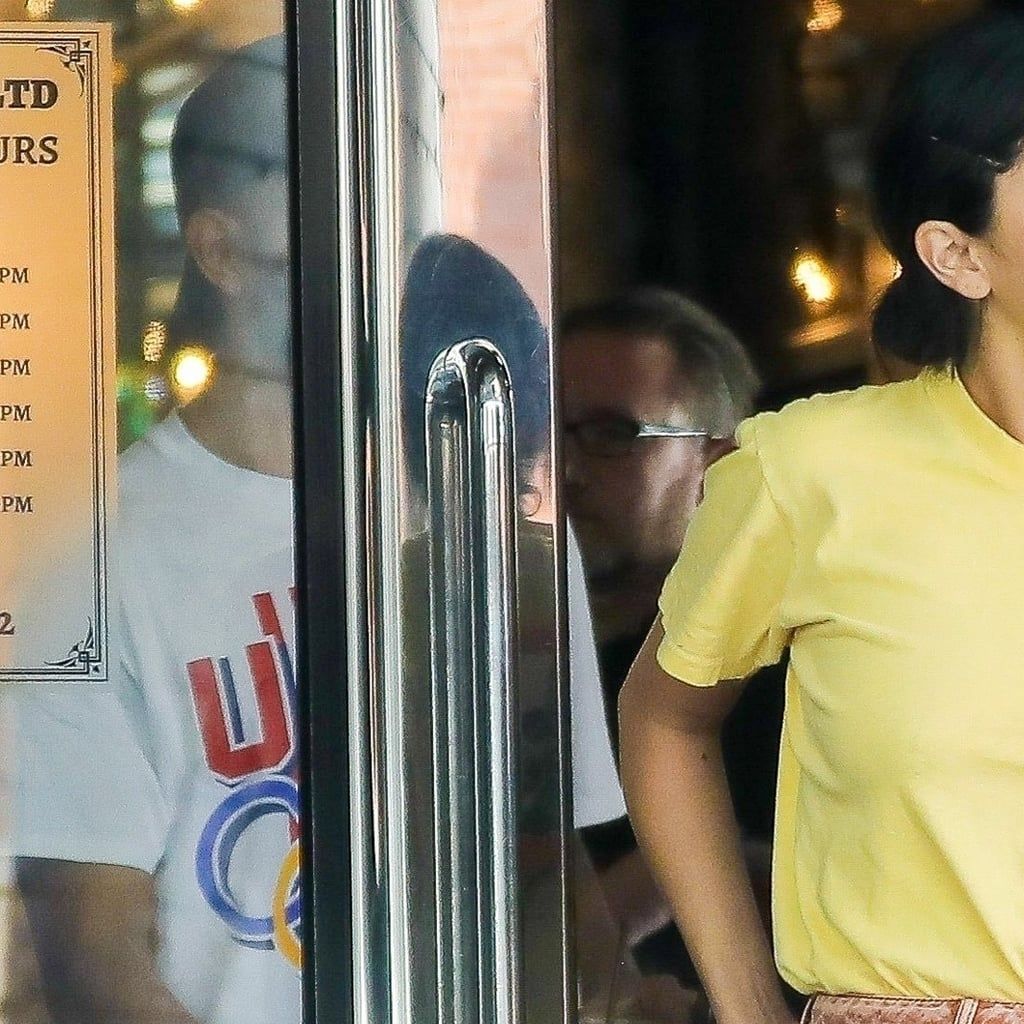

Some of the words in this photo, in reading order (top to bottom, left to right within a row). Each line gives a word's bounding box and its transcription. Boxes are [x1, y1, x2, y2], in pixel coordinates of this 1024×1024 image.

[0, 79, 59, 109] TD
[0, 267, 29, 283] PM
[0, 313, 30, 330] PM
[0, 359, 31, 376] PM
[0, 405, 32, 421] PM
[0, 450, 32, 467] PM
[1, 496, 33, 513] PM
